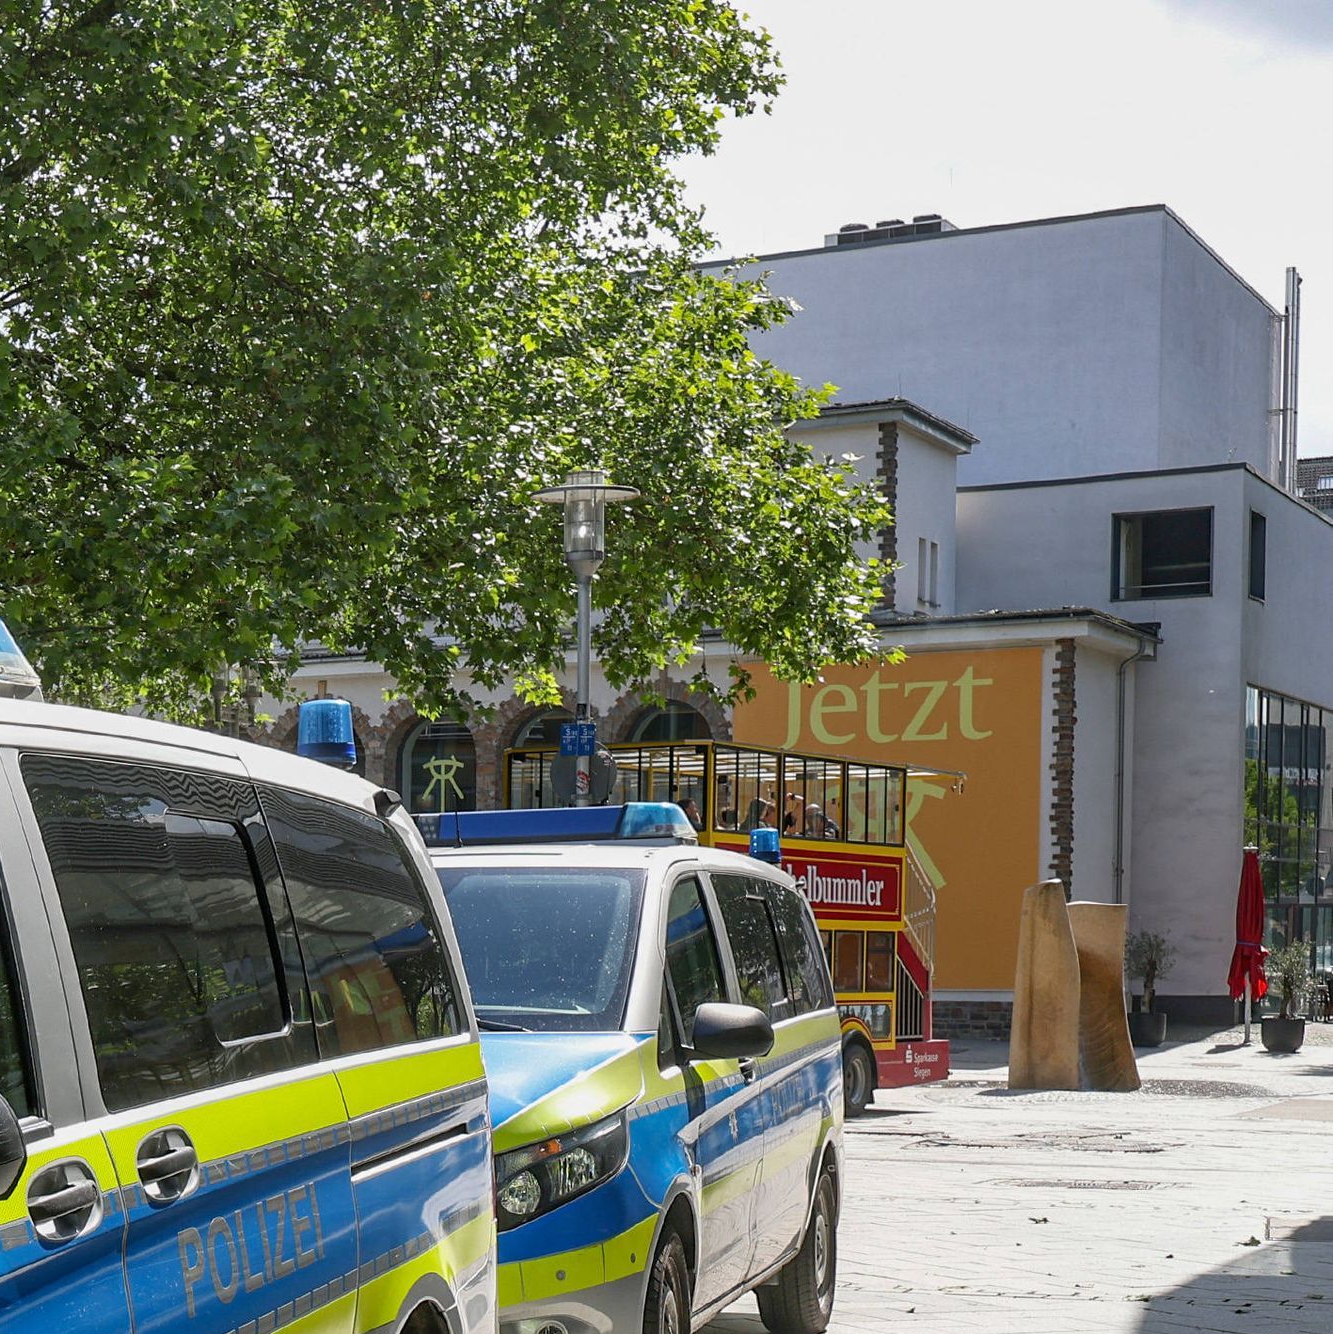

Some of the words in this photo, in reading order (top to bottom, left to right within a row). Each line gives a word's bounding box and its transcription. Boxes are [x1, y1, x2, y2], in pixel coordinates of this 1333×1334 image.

[779, 665, 993, 750] Jetzt
[914, 1052, 939, 1065] Sparkasse
[914, 1066, 932, 1080] Siegen
[177, 1181, 325, 1319] POLIZEI
